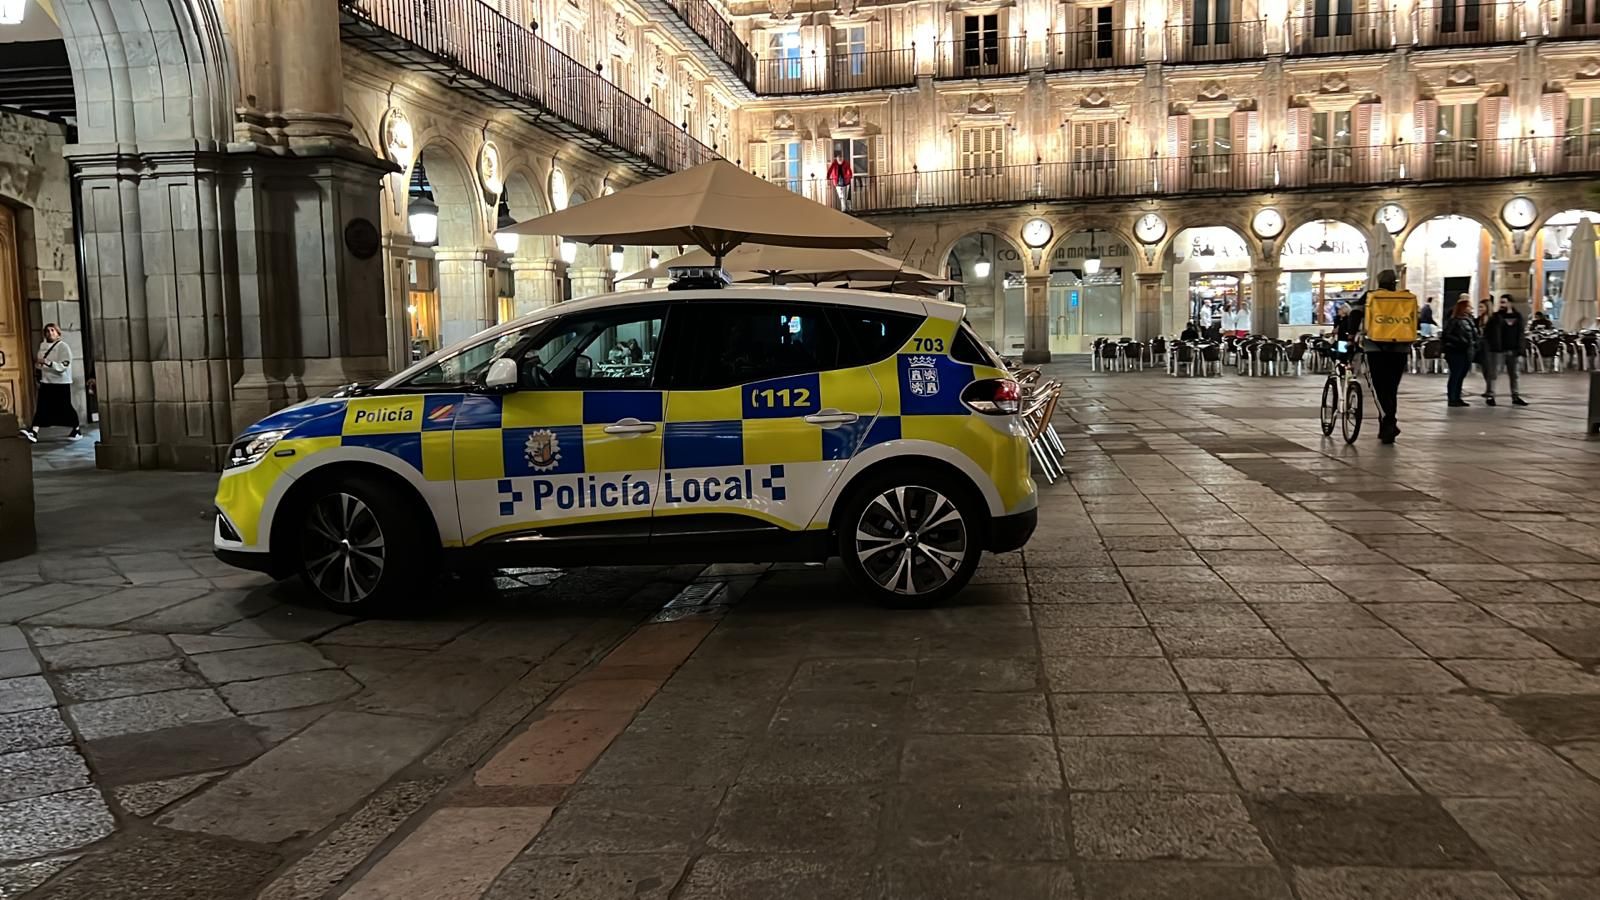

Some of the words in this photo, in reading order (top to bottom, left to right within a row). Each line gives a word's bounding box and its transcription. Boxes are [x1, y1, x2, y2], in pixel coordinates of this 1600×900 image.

[913, 338, 944, 352] 703
[355, 406, 413, 423] Policía
[533, 474, 650, 510] Policía
[665, 469, 753, 503] Local
